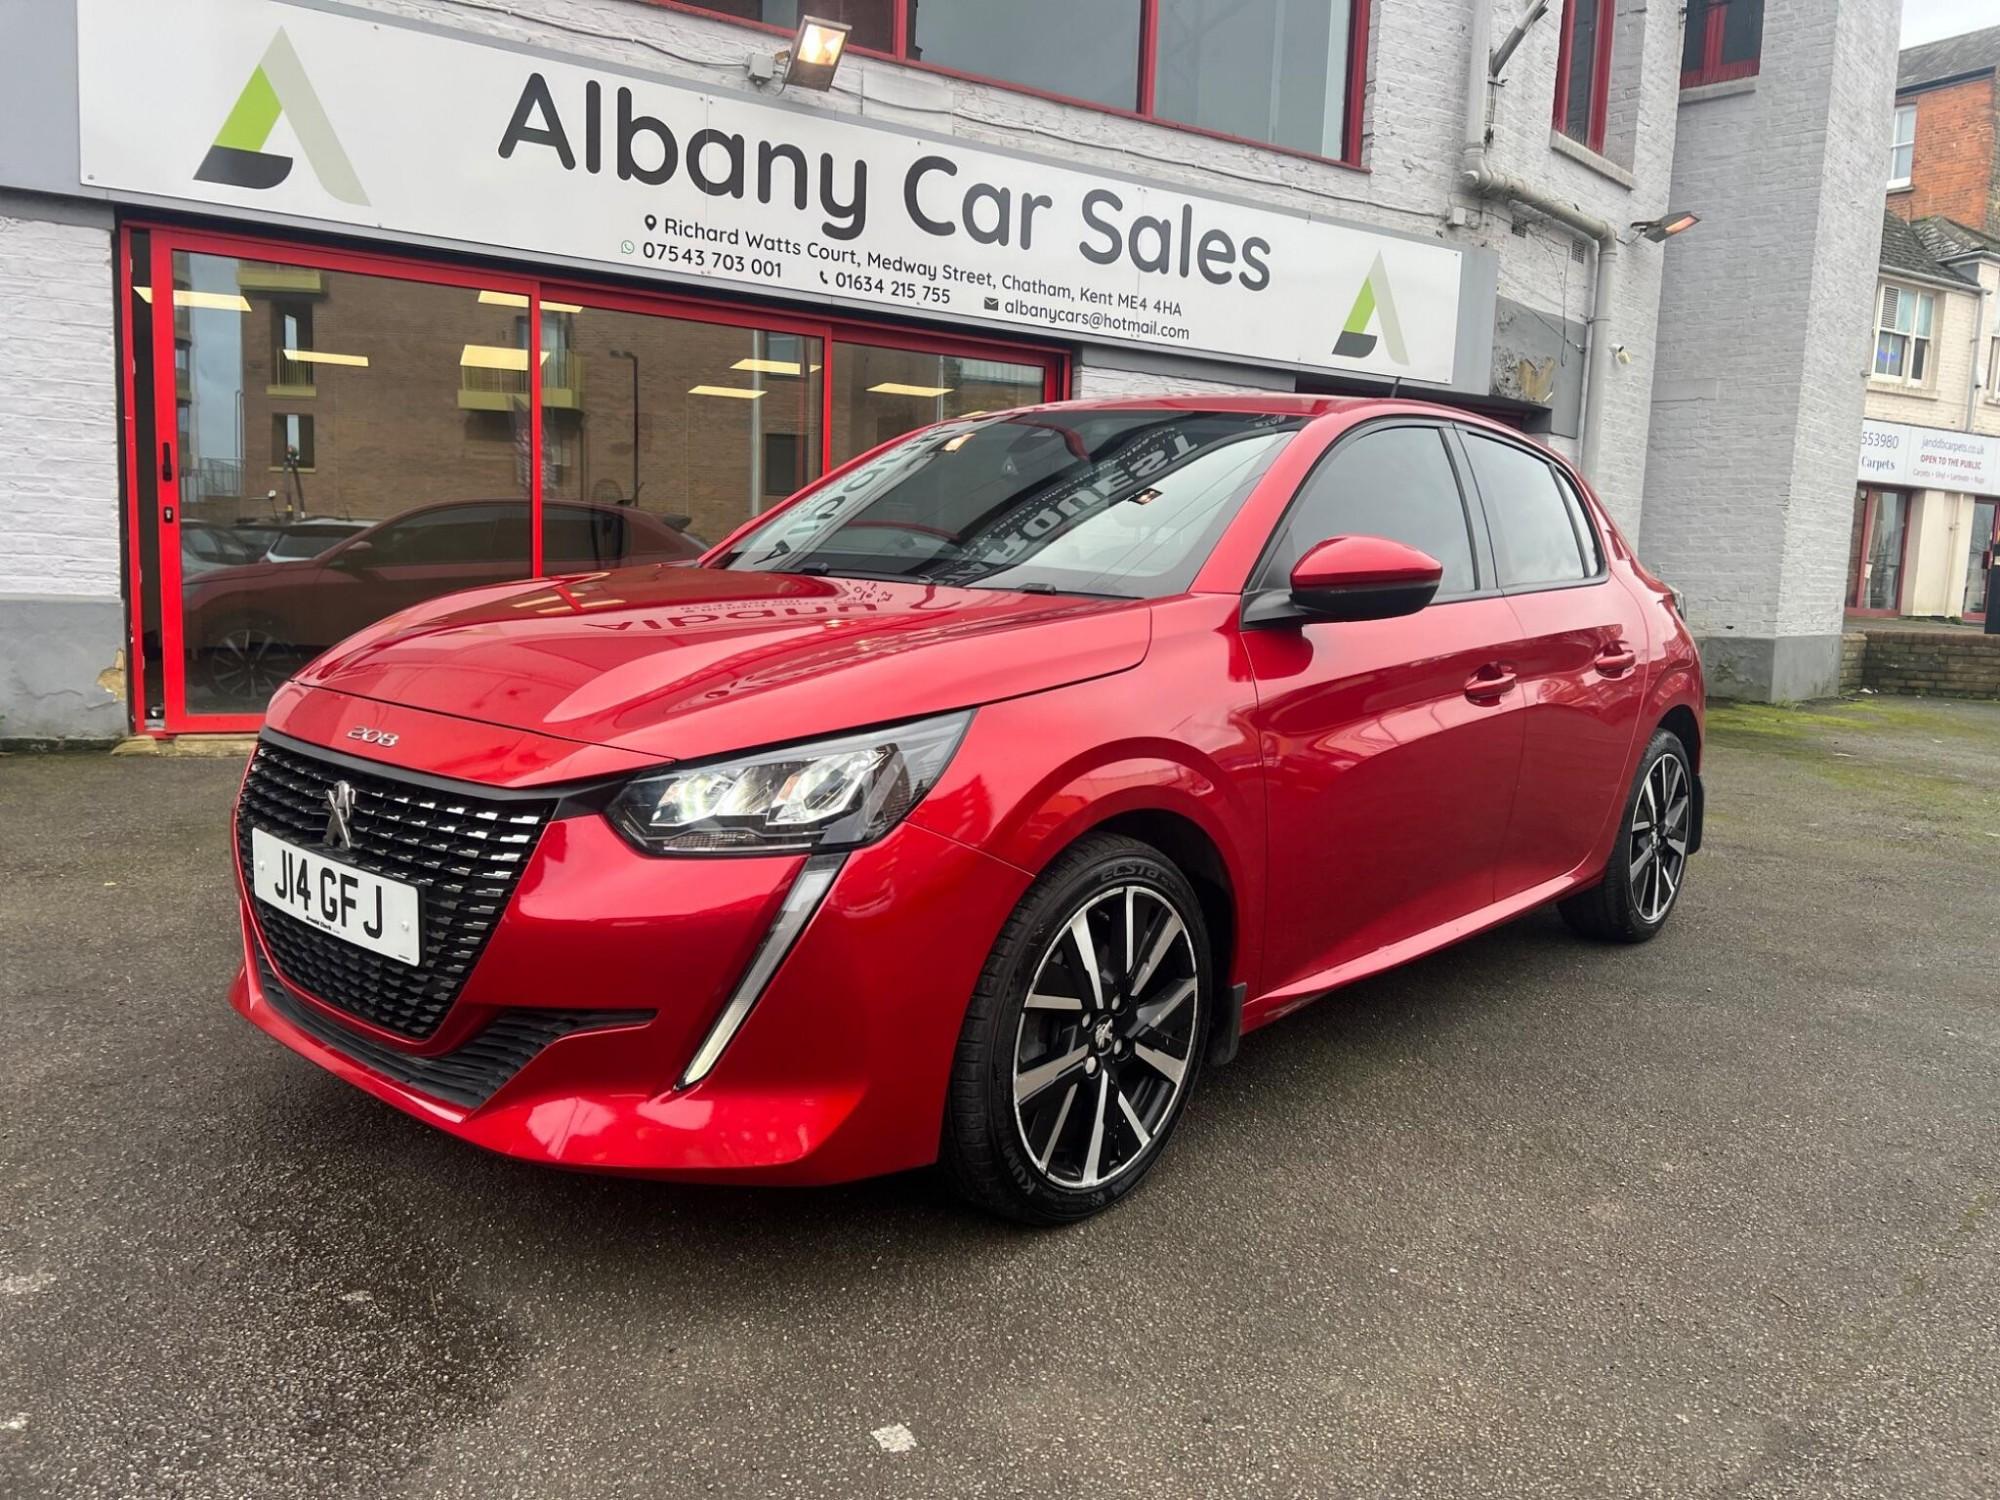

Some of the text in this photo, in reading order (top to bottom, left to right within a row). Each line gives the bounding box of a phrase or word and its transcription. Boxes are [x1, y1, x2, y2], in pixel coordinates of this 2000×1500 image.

[497, 72, 1272, 292] Albany Car Sales
[643, 241, 782, 278] 07543 703 001
[664, 217, 1182, 317] Richard Watts Court, Medway Street, Chatham, Kent ME4 4HA
[835, 271, 951, 304] 01634 215 755
[1004, 299, 1190, 340] albanycars@hotmail.com
[1861, 455, 1896, 472] Carpets
[1920, 454, 1982, 470] OPEN TO THE PUBLIC
[347, 726, 399, 747] 208
[274, 849, 383, 939] J14 GFJ
